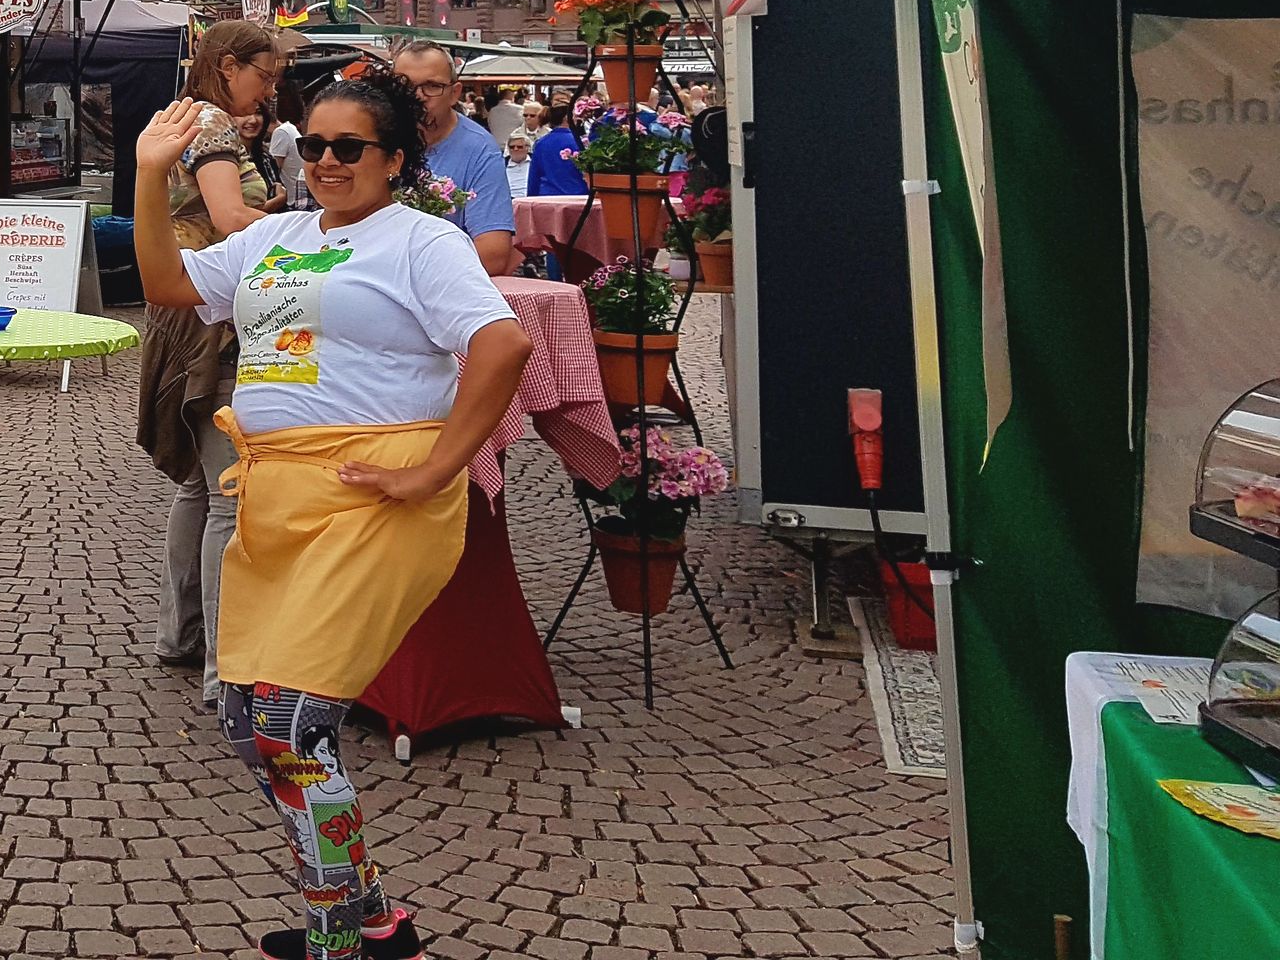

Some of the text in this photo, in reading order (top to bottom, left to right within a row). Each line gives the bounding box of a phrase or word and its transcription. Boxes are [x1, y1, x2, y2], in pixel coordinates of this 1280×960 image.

[8, 253, 43, 262] CRÊPES
[34, 293, 46, 301] mit
[242, 296, 298, 339] Brasilianische
[248, 307, 305, 347] Spezialitäten
